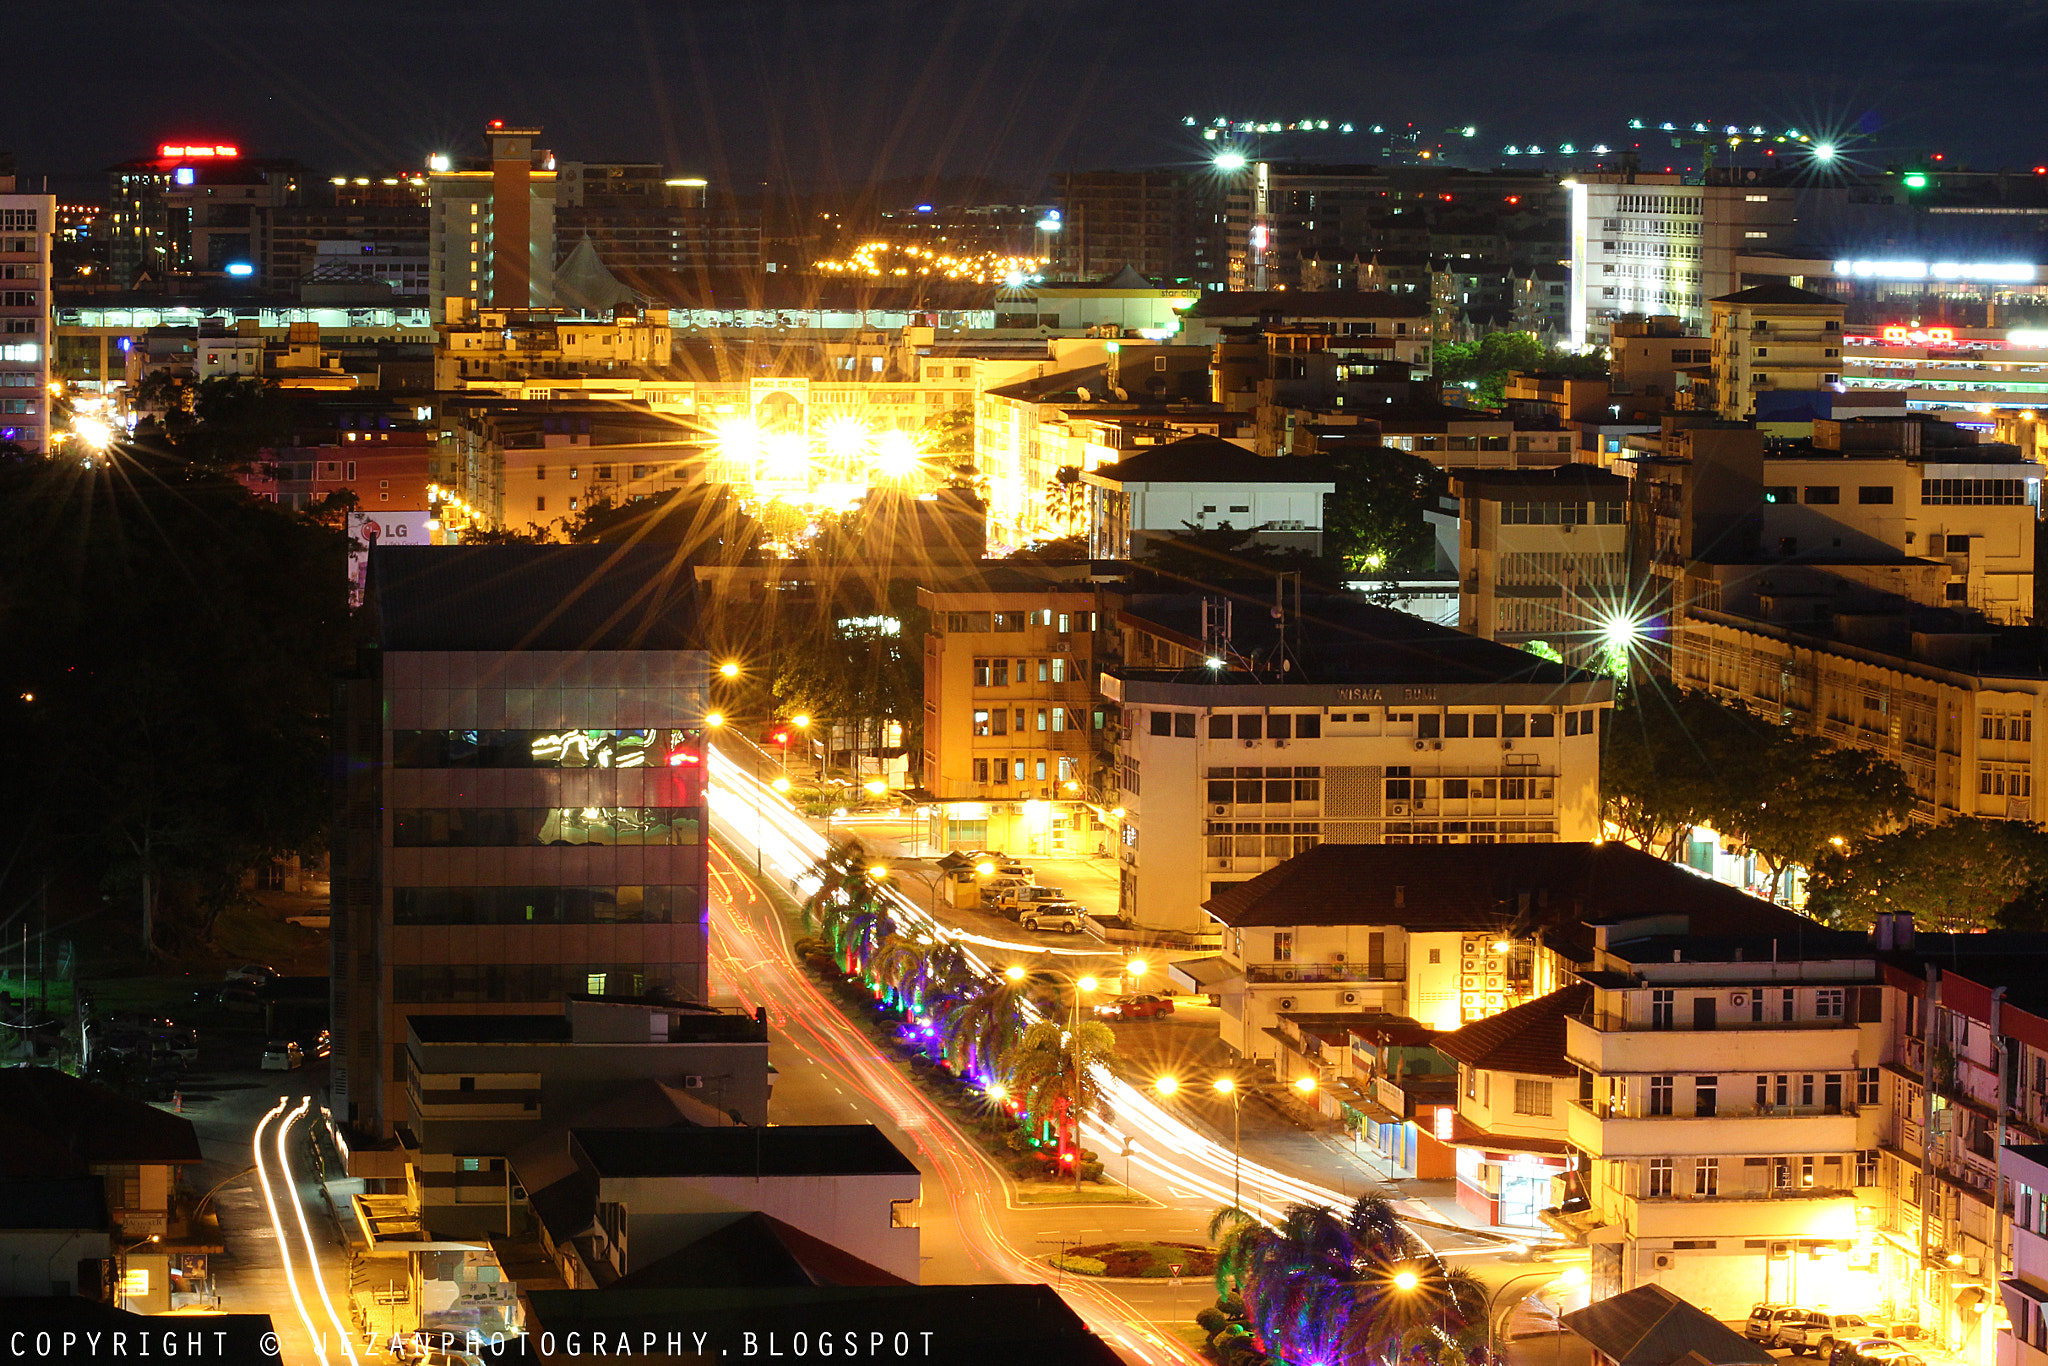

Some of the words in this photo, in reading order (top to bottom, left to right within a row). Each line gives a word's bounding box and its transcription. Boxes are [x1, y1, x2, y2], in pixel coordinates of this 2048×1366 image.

[1181, 289, 1198, 298] city
[385, 524, 408, 538] LG
[1338, 688, 1382, 700] WISMA
